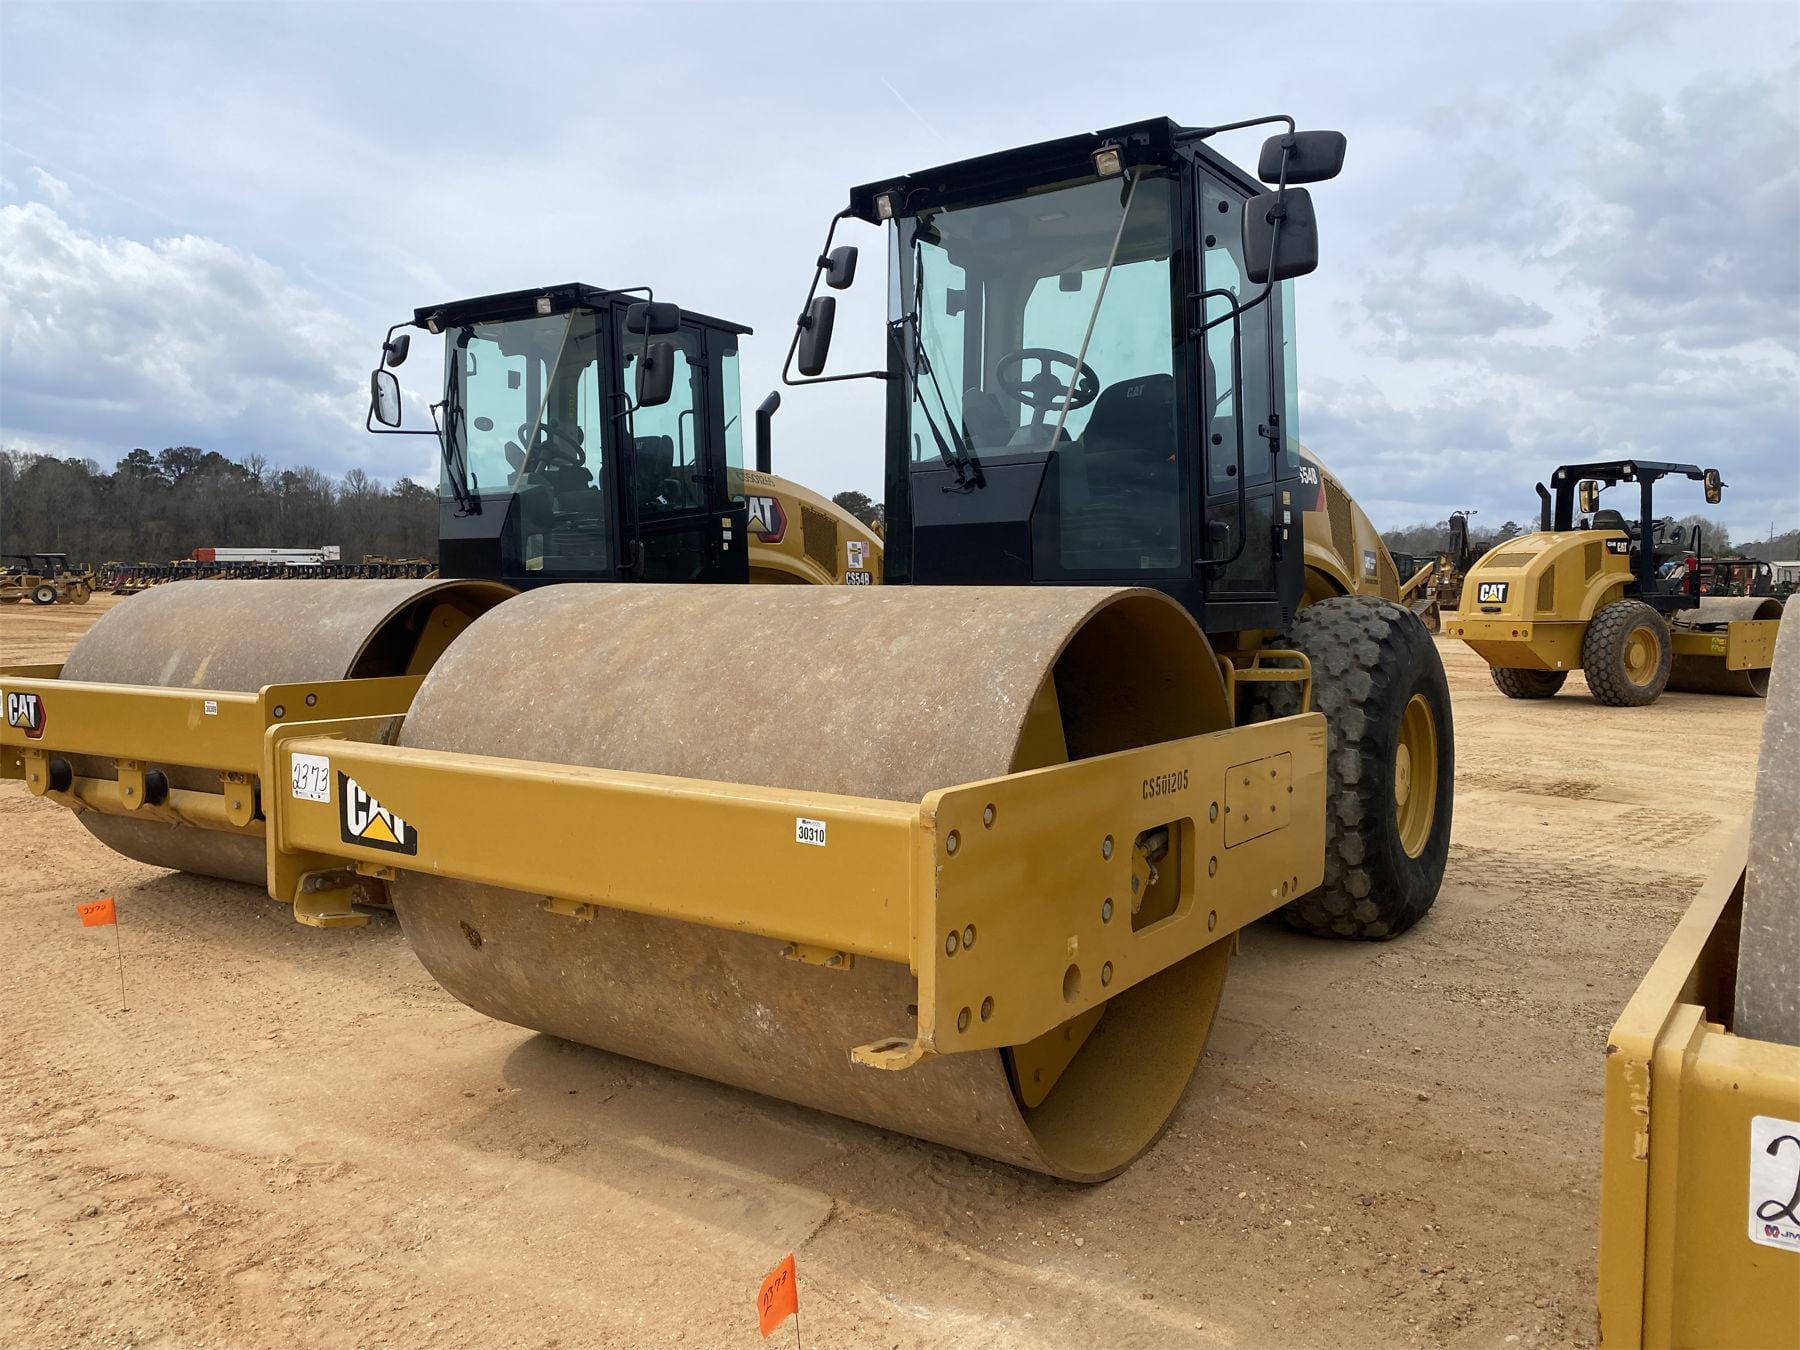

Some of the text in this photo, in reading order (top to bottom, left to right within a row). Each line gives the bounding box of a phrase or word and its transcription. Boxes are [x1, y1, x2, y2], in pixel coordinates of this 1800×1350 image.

[1127, 384, 1144, 398] CAT
[1299, 465, 1318, 485] S54B
[748, 497, 774, 533] AT
[1617, 542, 1627, 552] CAT
[845, 571, 870, 585] CS54B
[1480, 583, 1506, 602] CAT
[7, 693, 37, 728] CAT
[292, 763, 329, 792] 2373
[1142, 769, 1189, 800] CS501205
[798, 825, 825, 843] 30310
